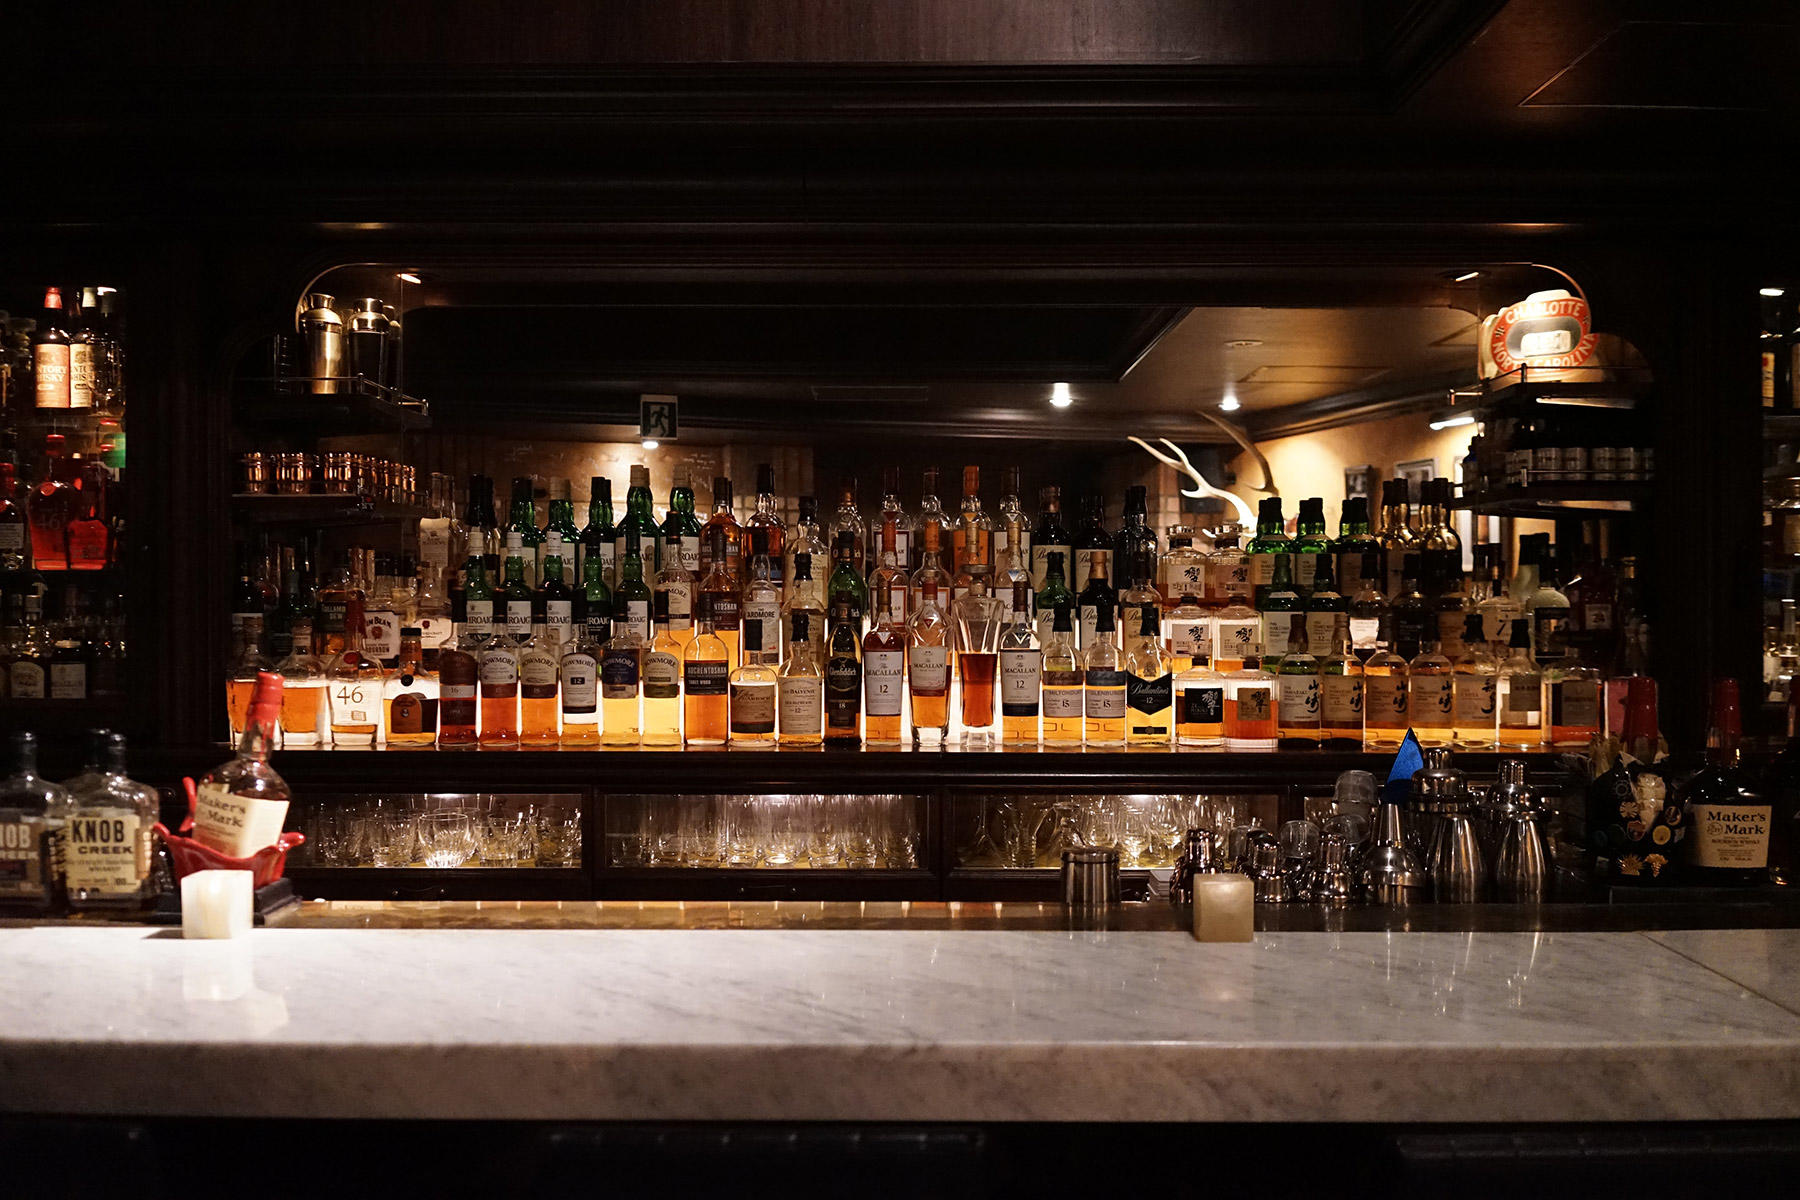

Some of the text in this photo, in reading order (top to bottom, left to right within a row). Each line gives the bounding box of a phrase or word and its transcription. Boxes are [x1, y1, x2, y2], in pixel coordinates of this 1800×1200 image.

[1492, 342, 1527, 371] NORT
[508, 616, 531, 624] ROAIG
[548, 616, 570, 624] ROAIG
[747, 611, 776, 619] ARDMORE
[587, 617, 610, 625] ROAIG
[879, 684, 889, 694] 12
[1016, 679, 1025, 689] 12
[336, 686, 364, 706] 46
[208, 809, 243, 829] Mark
[1706, 811, 1767, 822] Maker's
[71, 819, 125, 843] KNOB
[1724, 824, 1765, 835] Mark
[0, 824, 31, 848] OB
[0, 850, 38, 860] EEK
[77, 846, 134, 855] CREEK
